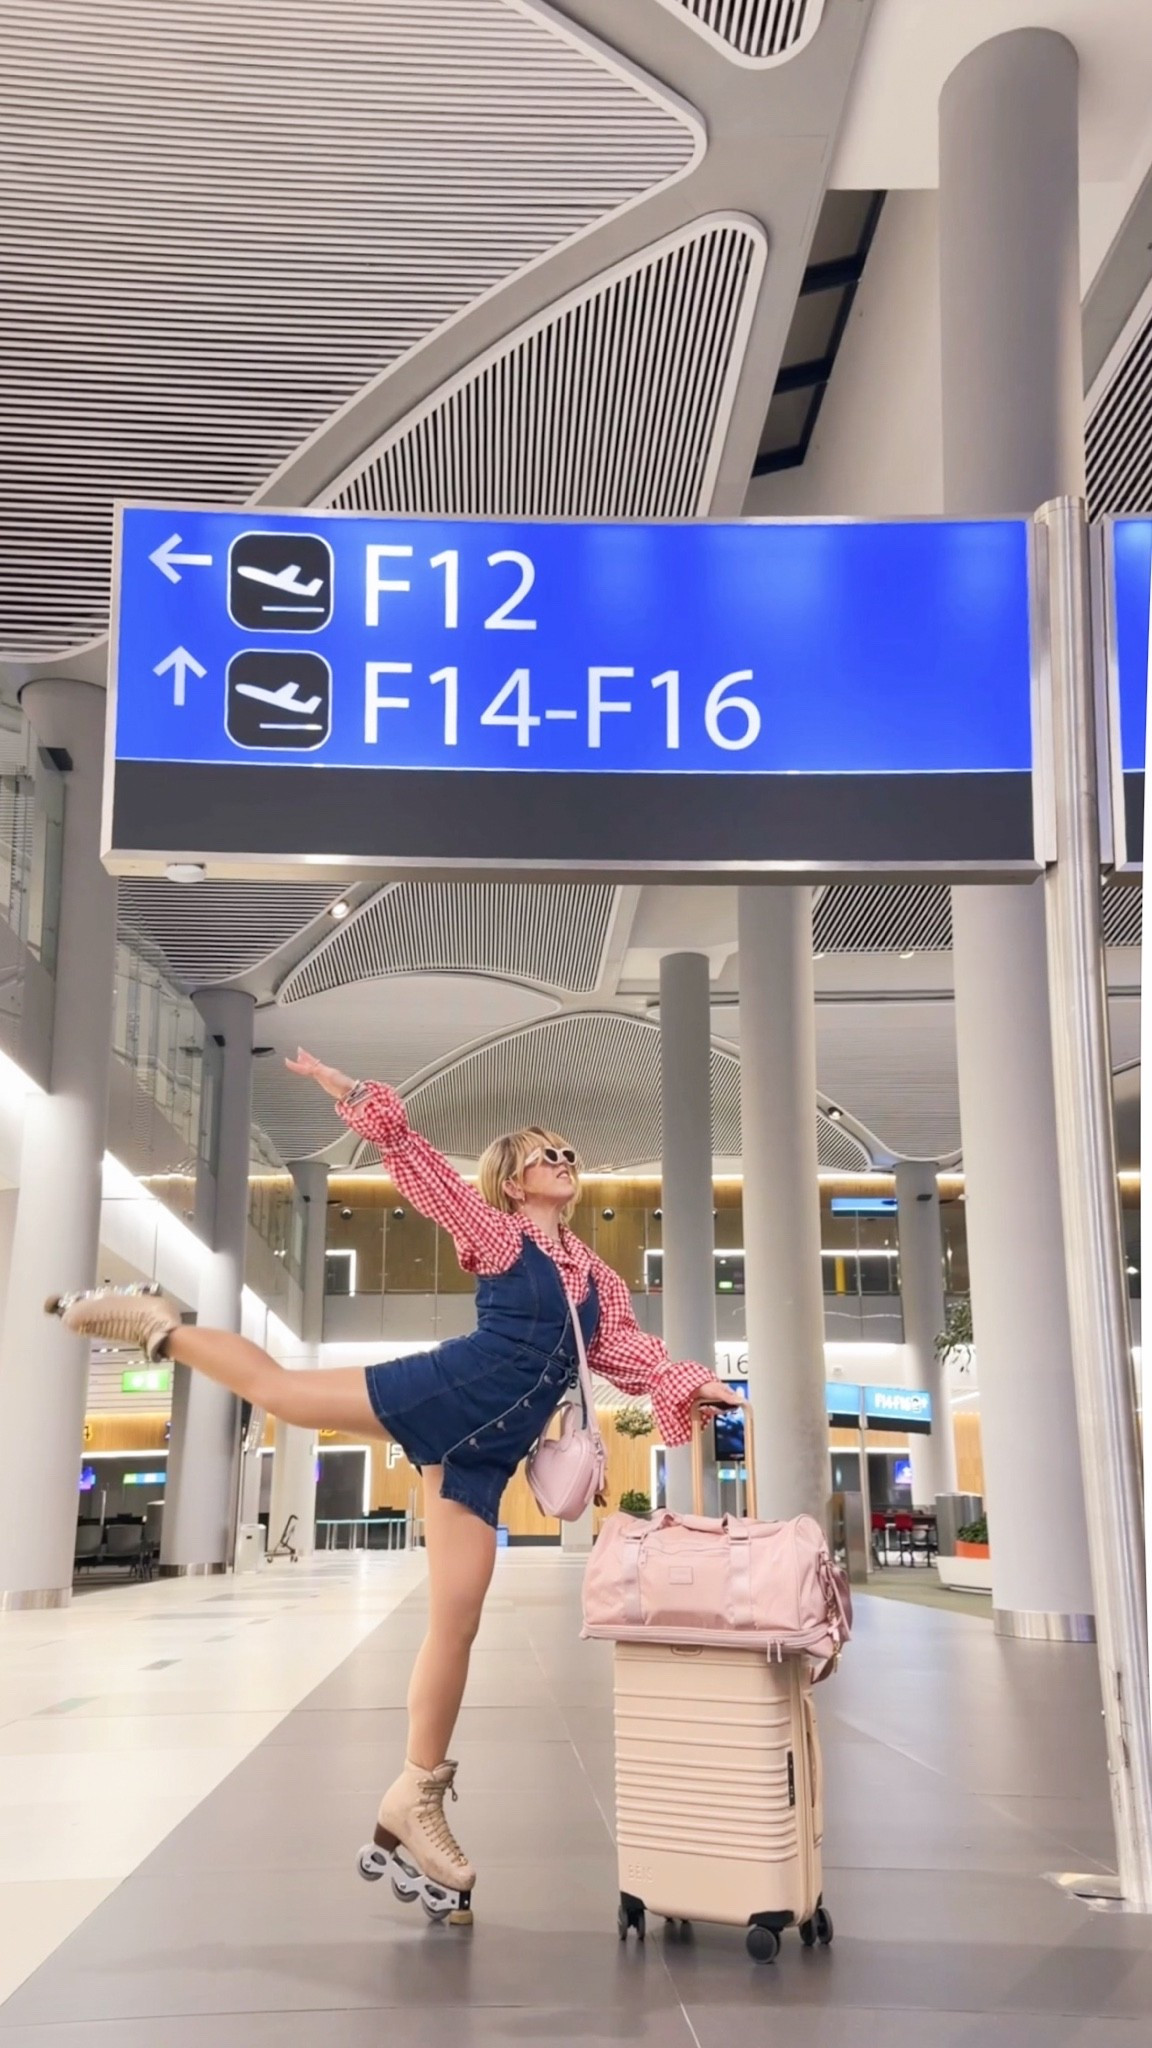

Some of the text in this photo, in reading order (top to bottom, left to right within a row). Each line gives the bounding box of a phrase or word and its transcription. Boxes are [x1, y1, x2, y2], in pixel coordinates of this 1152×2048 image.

[364, 543, 538, 630] F12
[363, 660, 762, 750] F14-F16
[713, 1351, 749, 1375] 16
